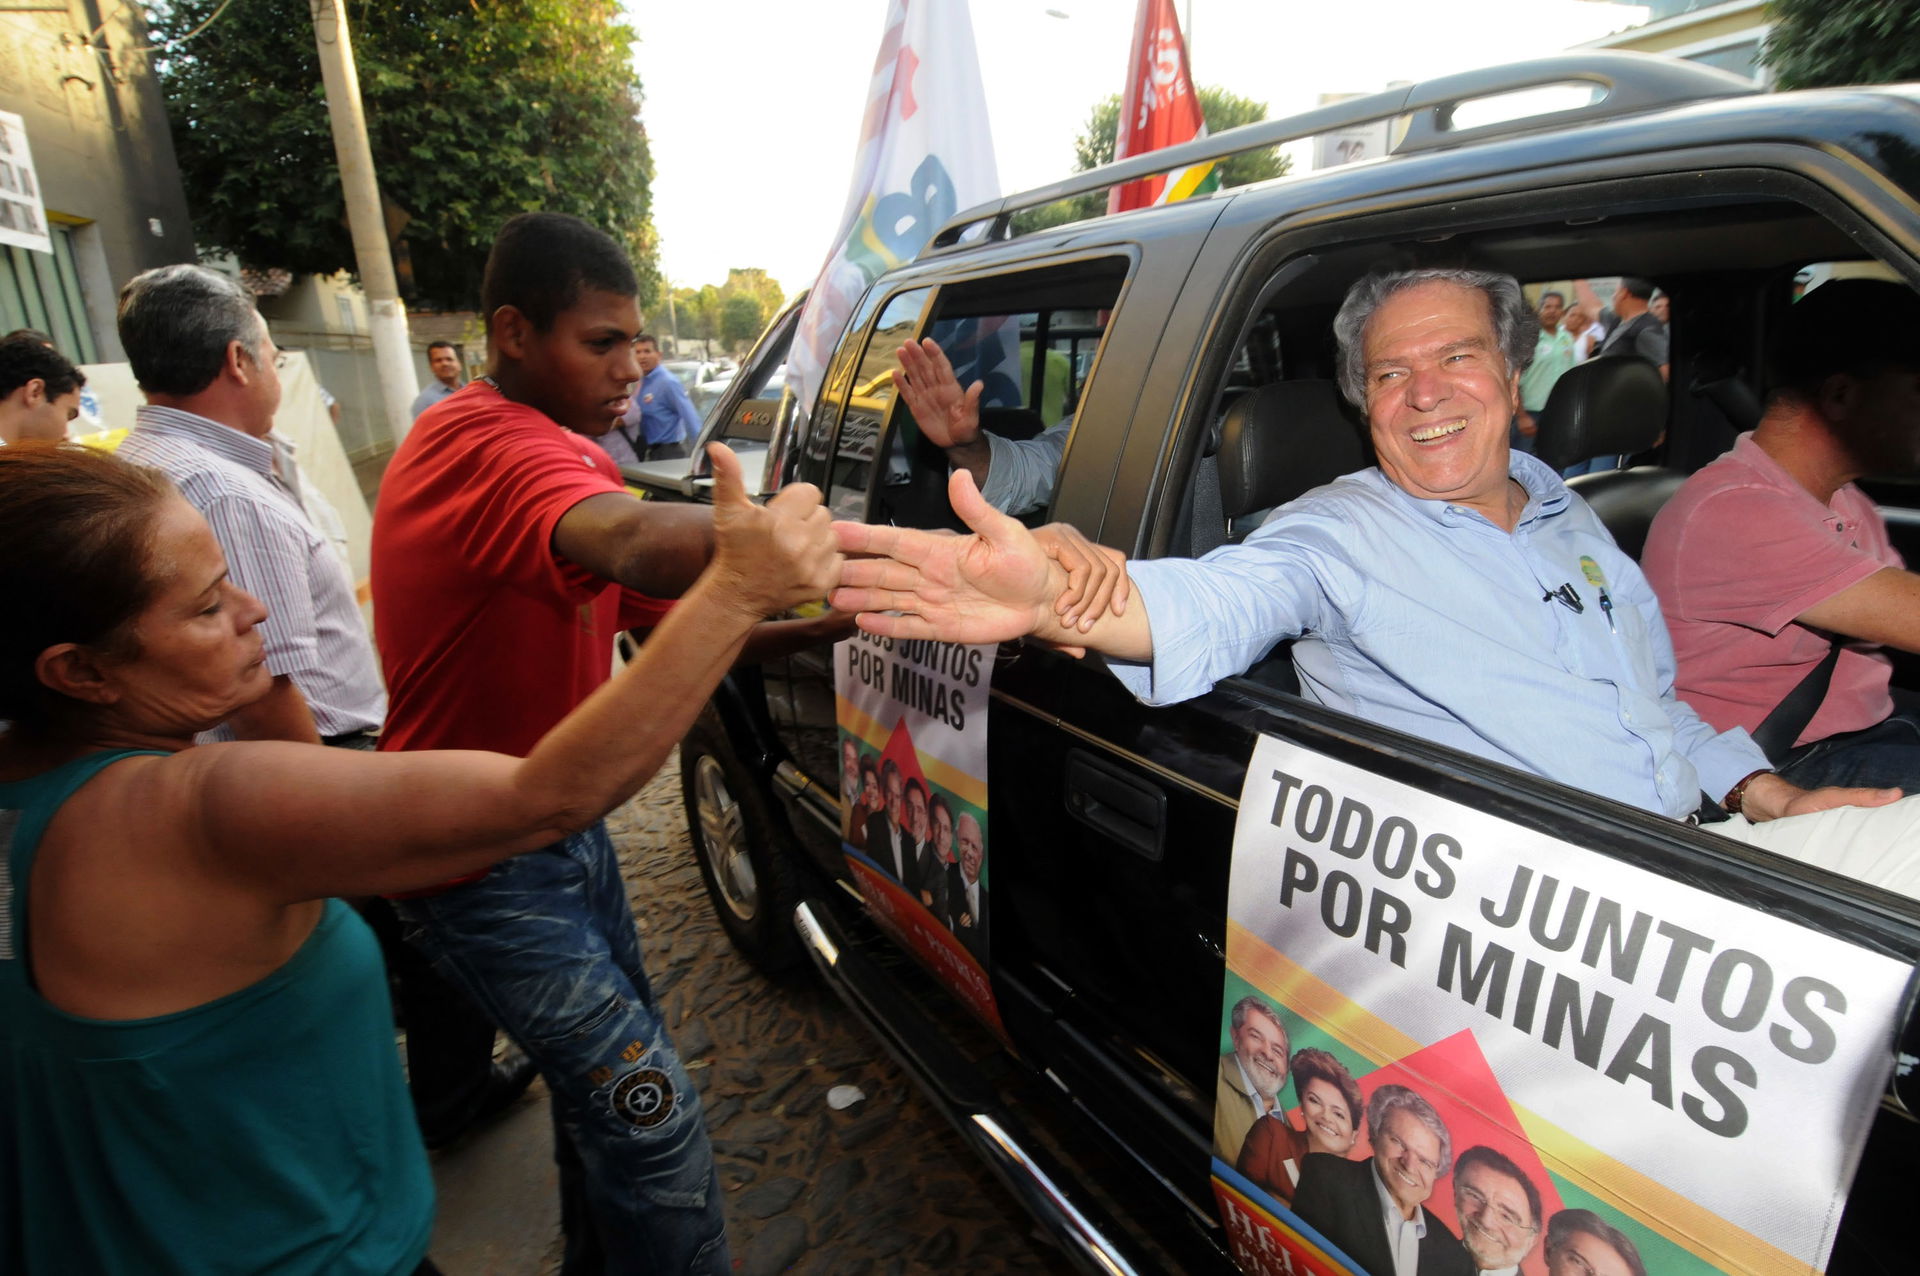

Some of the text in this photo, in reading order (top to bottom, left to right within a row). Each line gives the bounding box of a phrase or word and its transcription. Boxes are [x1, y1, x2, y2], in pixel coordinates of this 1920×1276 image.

[849, 644, 965, 731] POR MINAS
[900, 638, 982, 687] JUNTOS
[1270, 769, 1847, 1065] TODOS JUNTOS
[1280, 847, 1758, 1138] POR MINAS
